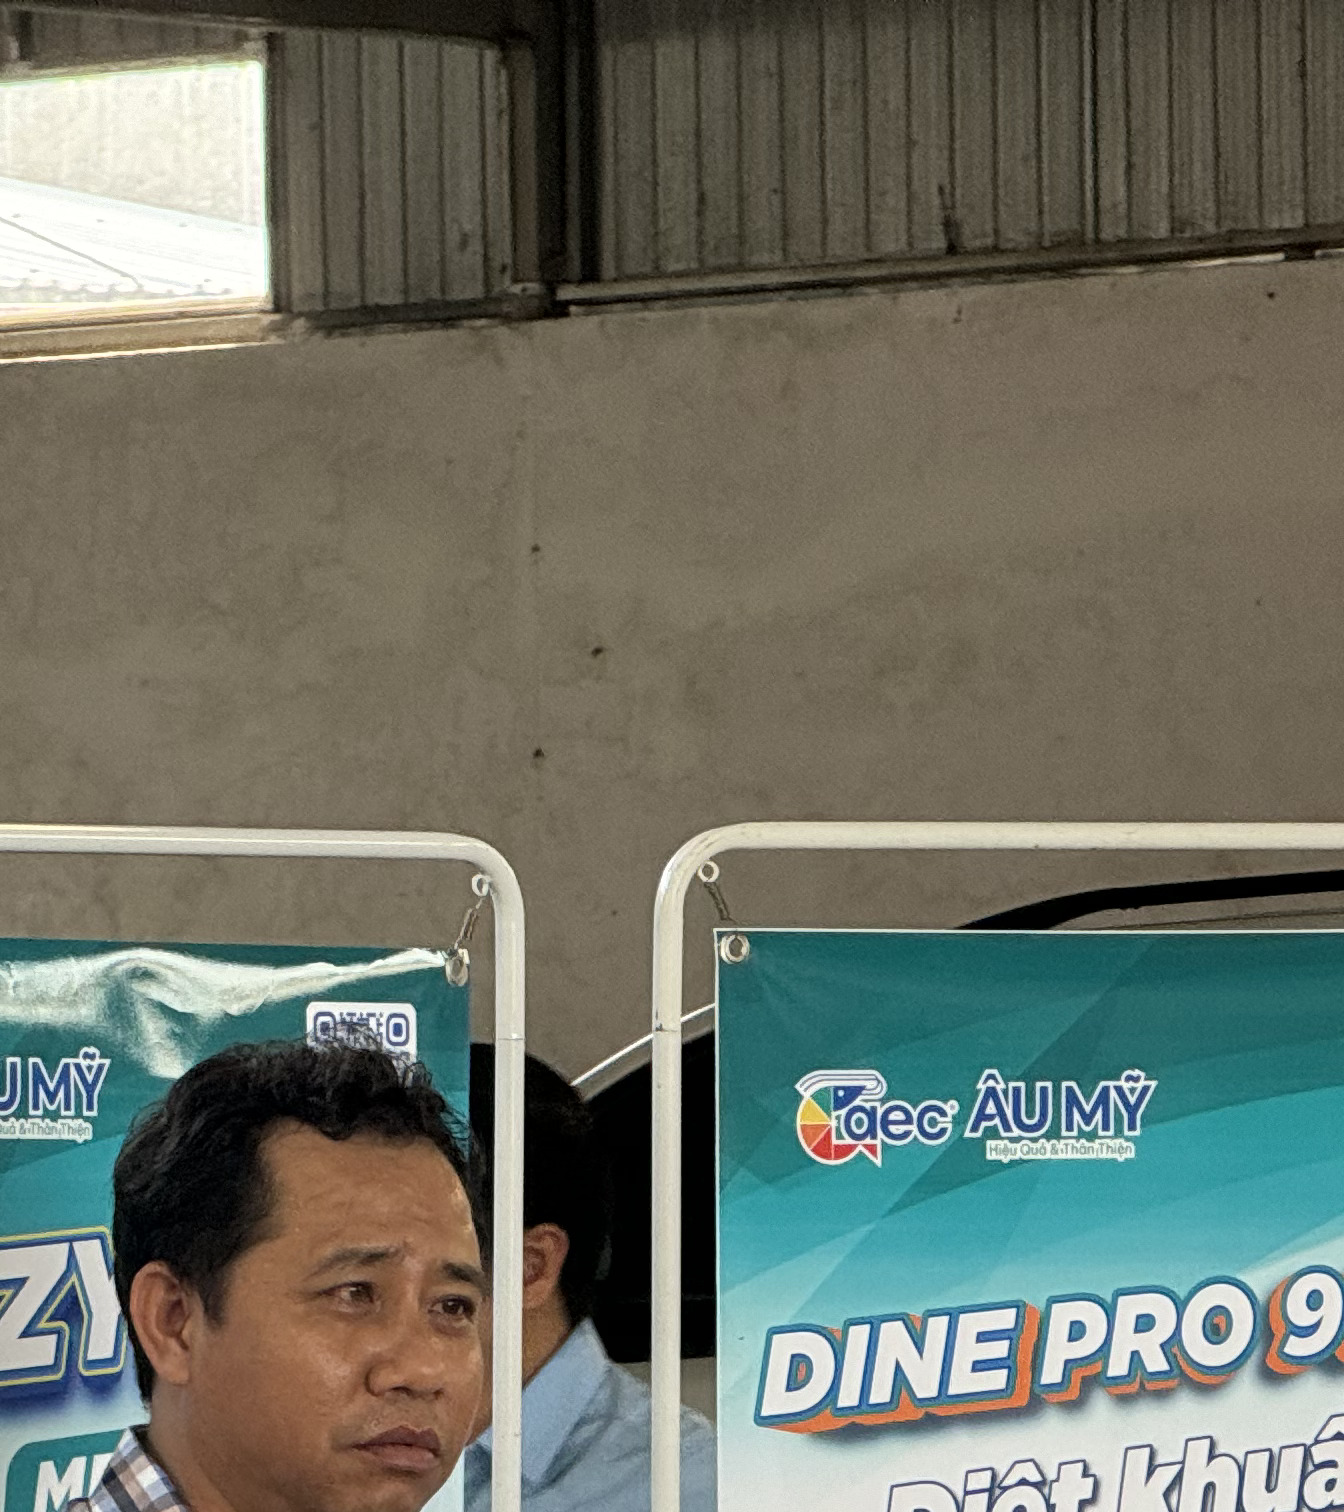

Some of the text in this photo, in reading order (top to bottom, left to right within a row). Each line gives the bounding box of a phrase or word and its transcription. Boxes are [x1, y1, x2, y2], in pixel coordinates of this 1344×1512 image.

[32, 1048, 109, 1113] MỸ
[967, 1072, 1051, 1135] ÂU
[1063, 1073, 1154, 1135] MỸ
[755, 1301, 1038, 1432] DINE
[1037, 1273, 1257, 1400] PRO
